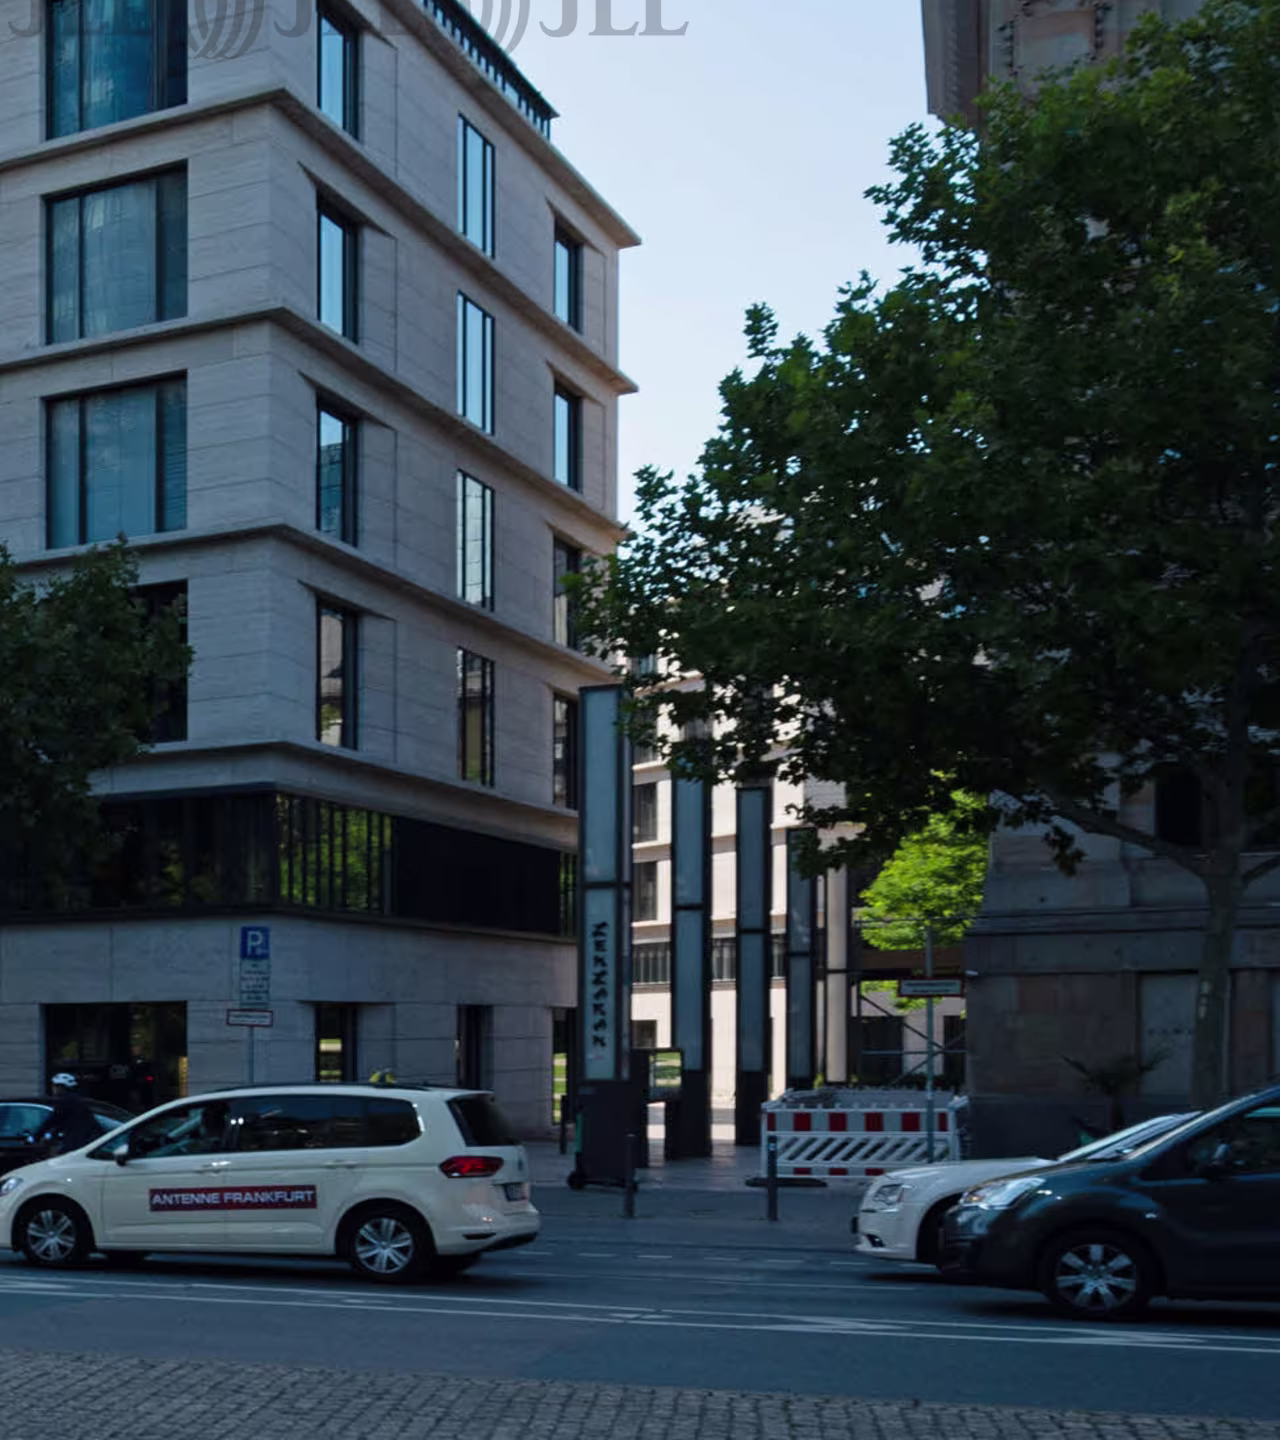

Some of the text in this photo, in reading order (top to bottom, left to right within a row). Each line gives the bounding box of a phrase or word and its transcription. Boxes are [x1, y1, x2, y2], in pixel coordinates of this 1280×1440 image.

[247, 930, 263, 957] P
[152, 1190, 314, 1205] ANTENNE FRANKFURT
